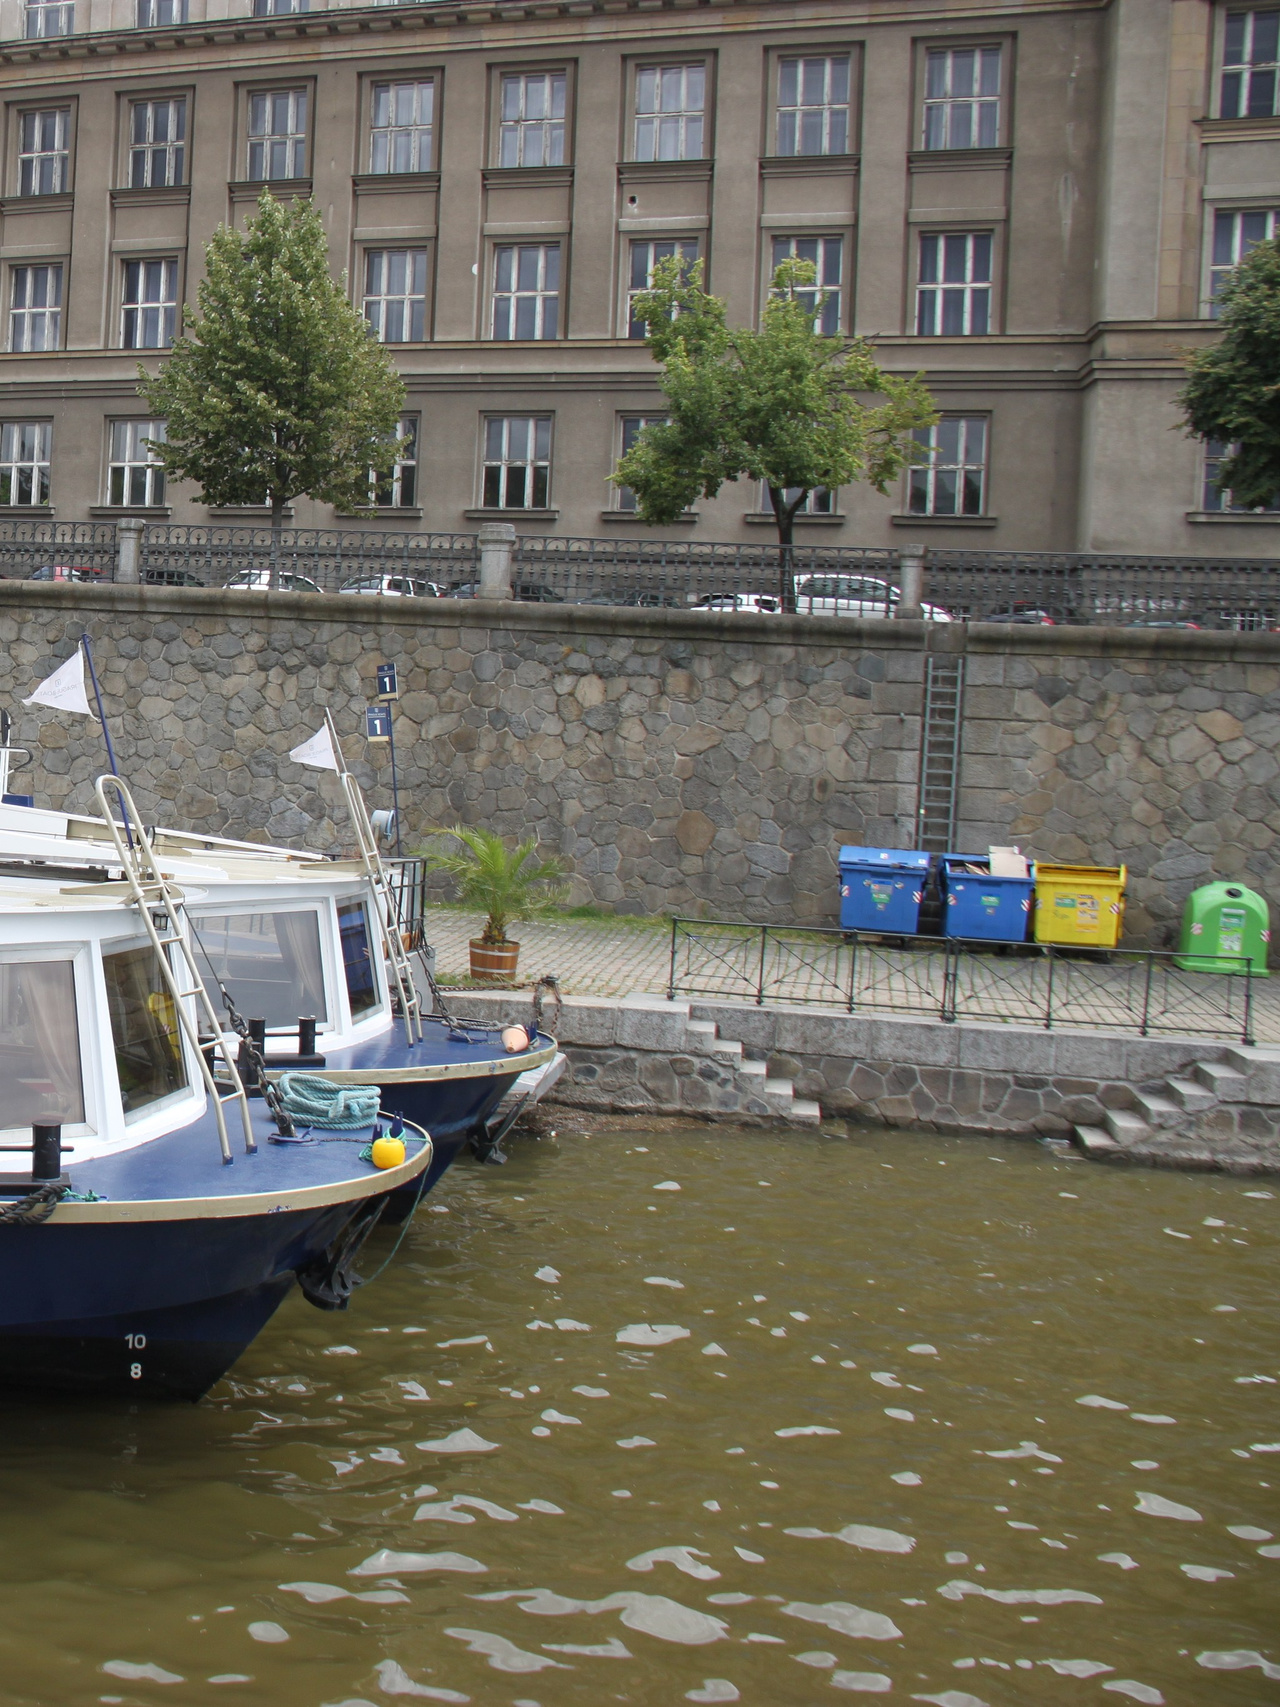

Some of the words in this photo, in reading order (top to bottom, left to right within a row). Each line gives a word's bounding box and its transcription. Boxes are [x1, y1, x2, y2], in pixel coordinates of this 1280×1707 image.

[384, 676, 391, 692] 1
[373, 719, 381, 735] 1
[124, 1333, 147, 1350] 10
[130, 1362, 142, 1380] 8
